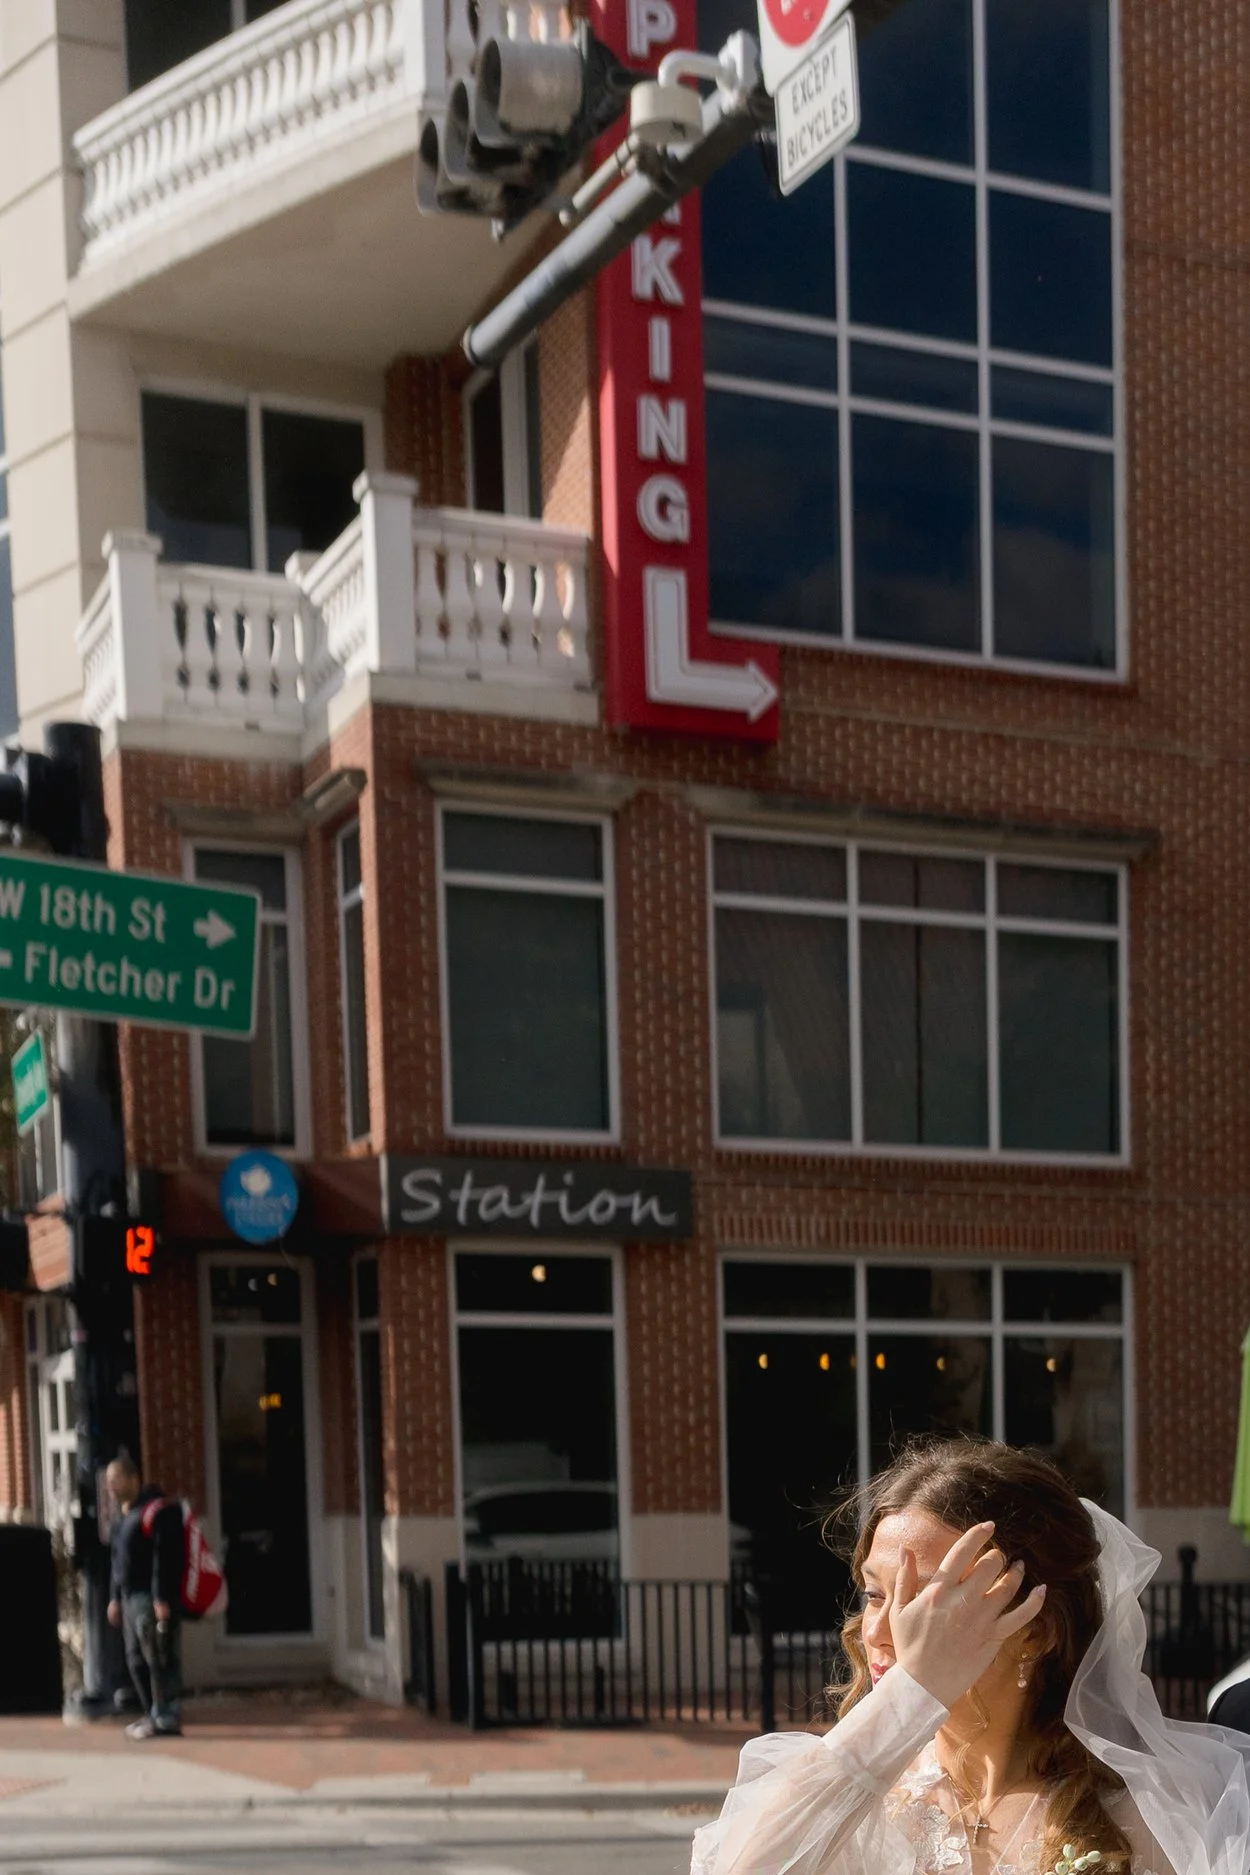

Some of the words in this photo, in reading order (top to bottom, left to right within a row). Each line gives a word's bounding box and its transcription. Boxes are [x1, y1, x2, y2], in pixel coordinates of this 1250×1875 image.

[791, 45, 838, 115] EXCEPT
[785, 88, 849, 168] BICYCLES
[625, 0, 691, 543] PKING
[40, 882, 117, 936] 18th
[128, 897, 166, 943] St
[24, 941, 182, 1004] Fletcher
[194, 966, 236, 1011] Dr
[399, 1167, 679, 1229] Station
[125, 1225, 154, 1275] 12
